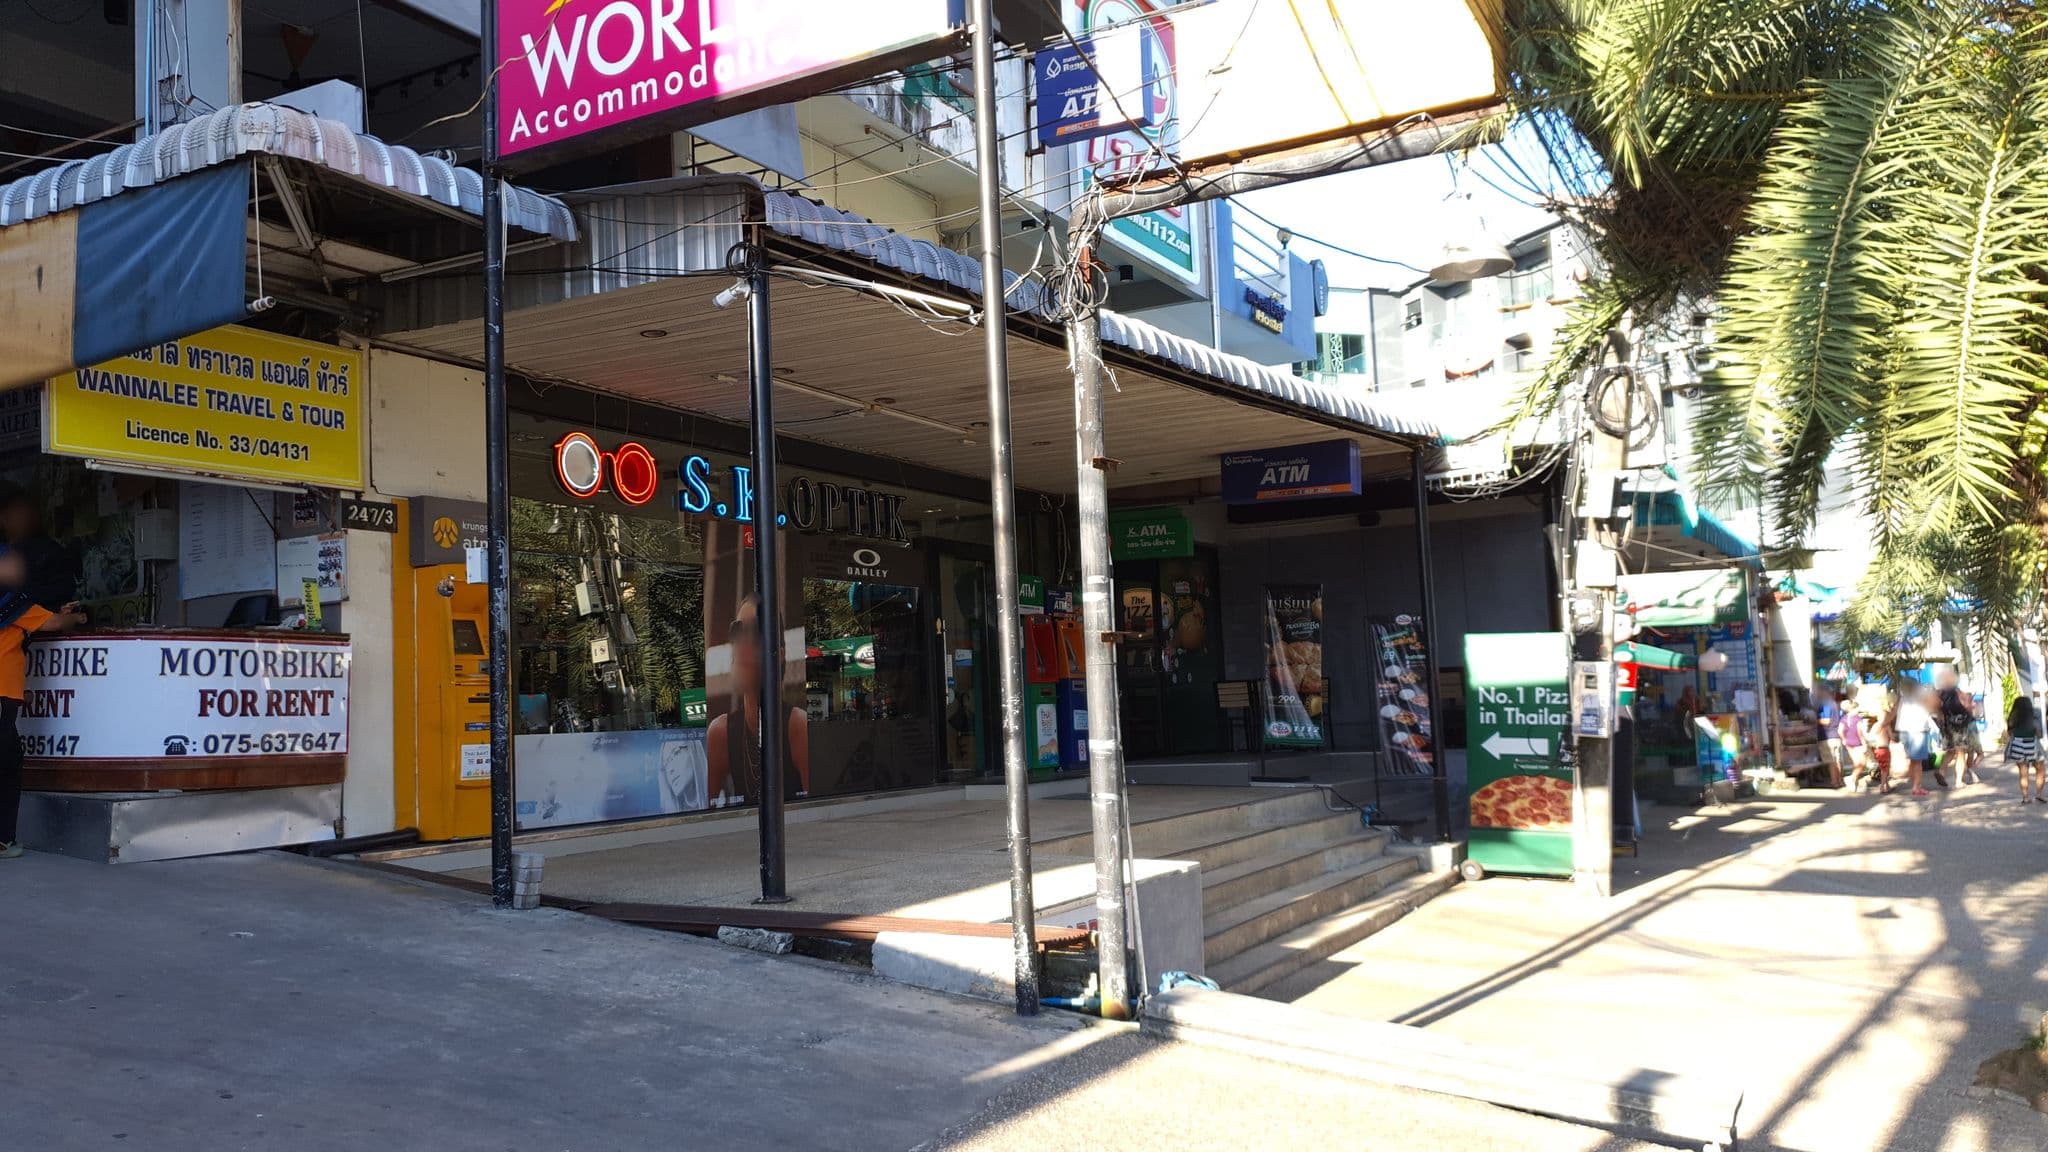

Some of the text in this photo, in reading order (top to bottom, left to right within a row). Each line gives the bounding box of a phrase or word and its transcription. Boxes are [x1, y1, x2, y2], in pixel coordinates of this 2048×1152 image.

[521, 0, 734, 98] WORL
[509, 38, 794, 142] Accommodatio
[1060, 91, 1101, 118] AT
[187, 344, 254, 380] ทราเวล
[261, 356, 310, 389] แอนด์
[316, 361, 349, 396] ทัวร์
[75, 368, 345, 430] WANNALEE TRAVEL & TOUR
[126, 420, 309, 461] Licence No. 33/04131
[1260, 464, 1310, 485] ATM
[348, 505, 393, 526] 247/3
[462, 521, 488, 533] krungs
[1140, 524, 1167, 536] ATM
[847, 566, 889, 578] OAKLEY
[1019, 583, 1036, 598] ATM
[1123, 605, 1153, 619] IZZ
[159, 647, 344, 678] MOTORBIKE
[21, 689, 75, 718] RENT
[198, 689, 334, 717] FOR RENT
[1535, 687, 1568, 704] Pizz
[1480, 708, 1496, 724] in
